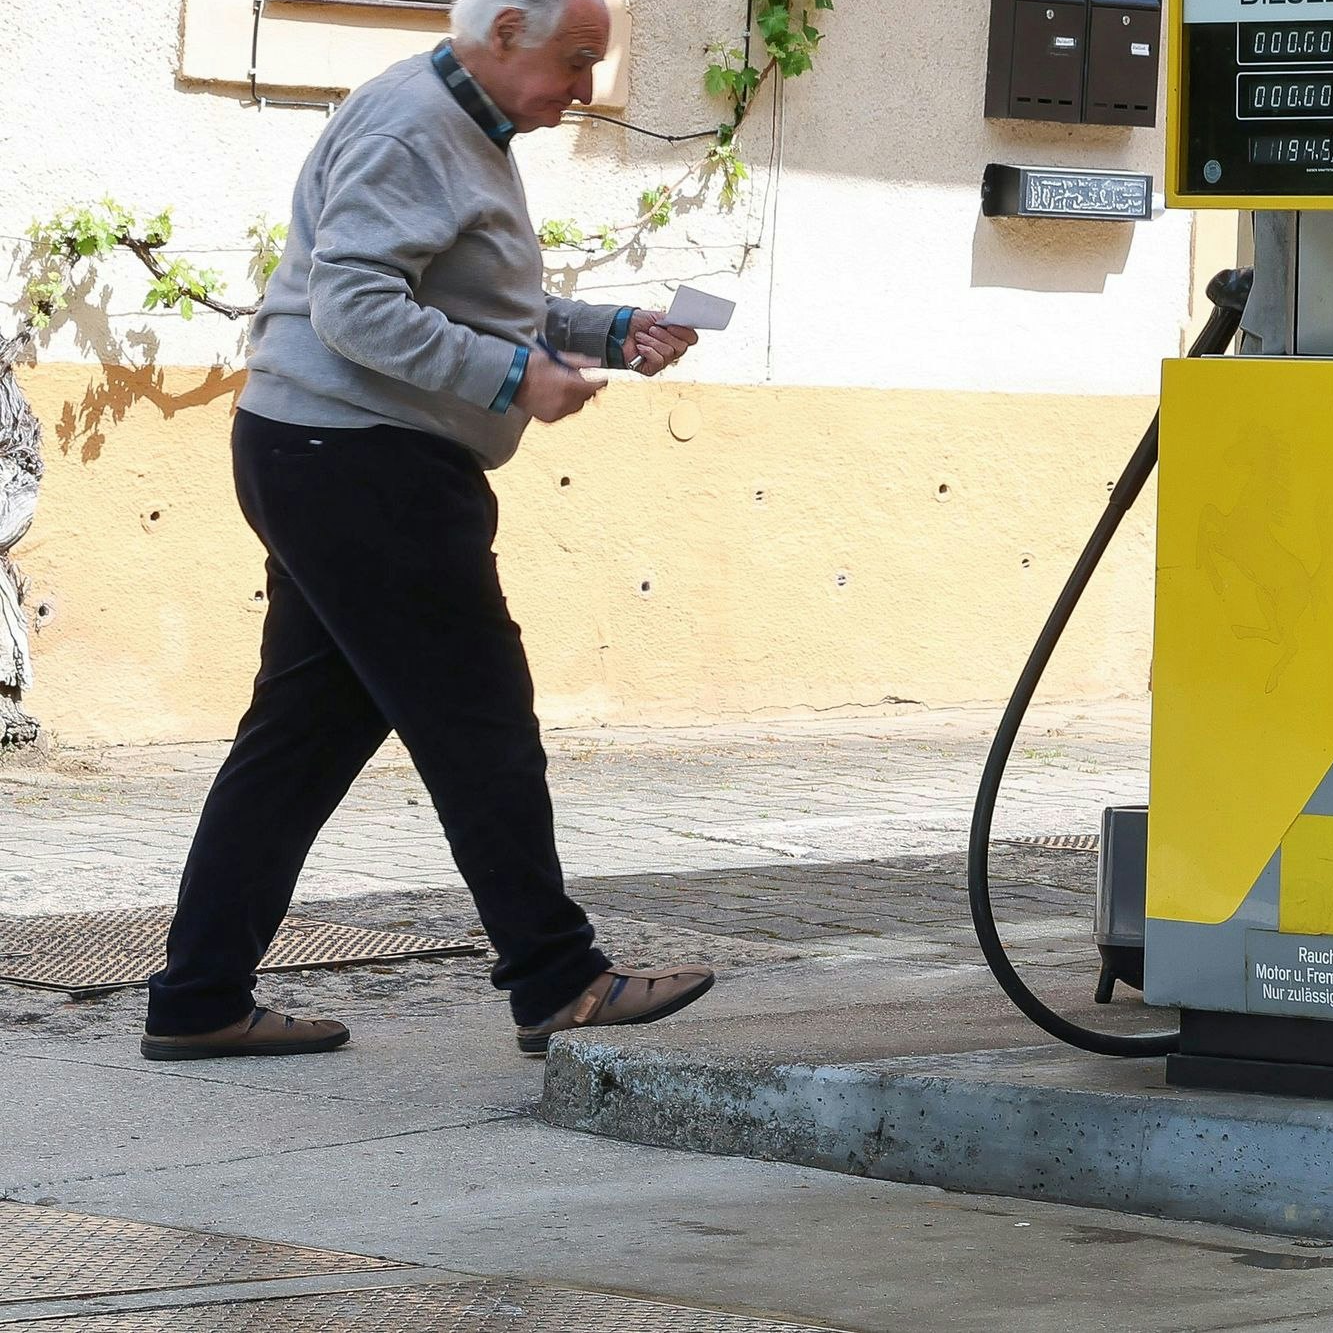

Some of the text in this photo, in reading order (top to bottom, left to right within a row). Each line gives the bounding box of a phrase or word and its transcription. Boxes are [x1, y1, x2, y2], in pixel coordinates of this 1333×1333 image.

[1255, 963, 1292, 981] Motor
[1293, 971, 1305, 983] u.
[1263, 983, 1285, 1001] Nur
